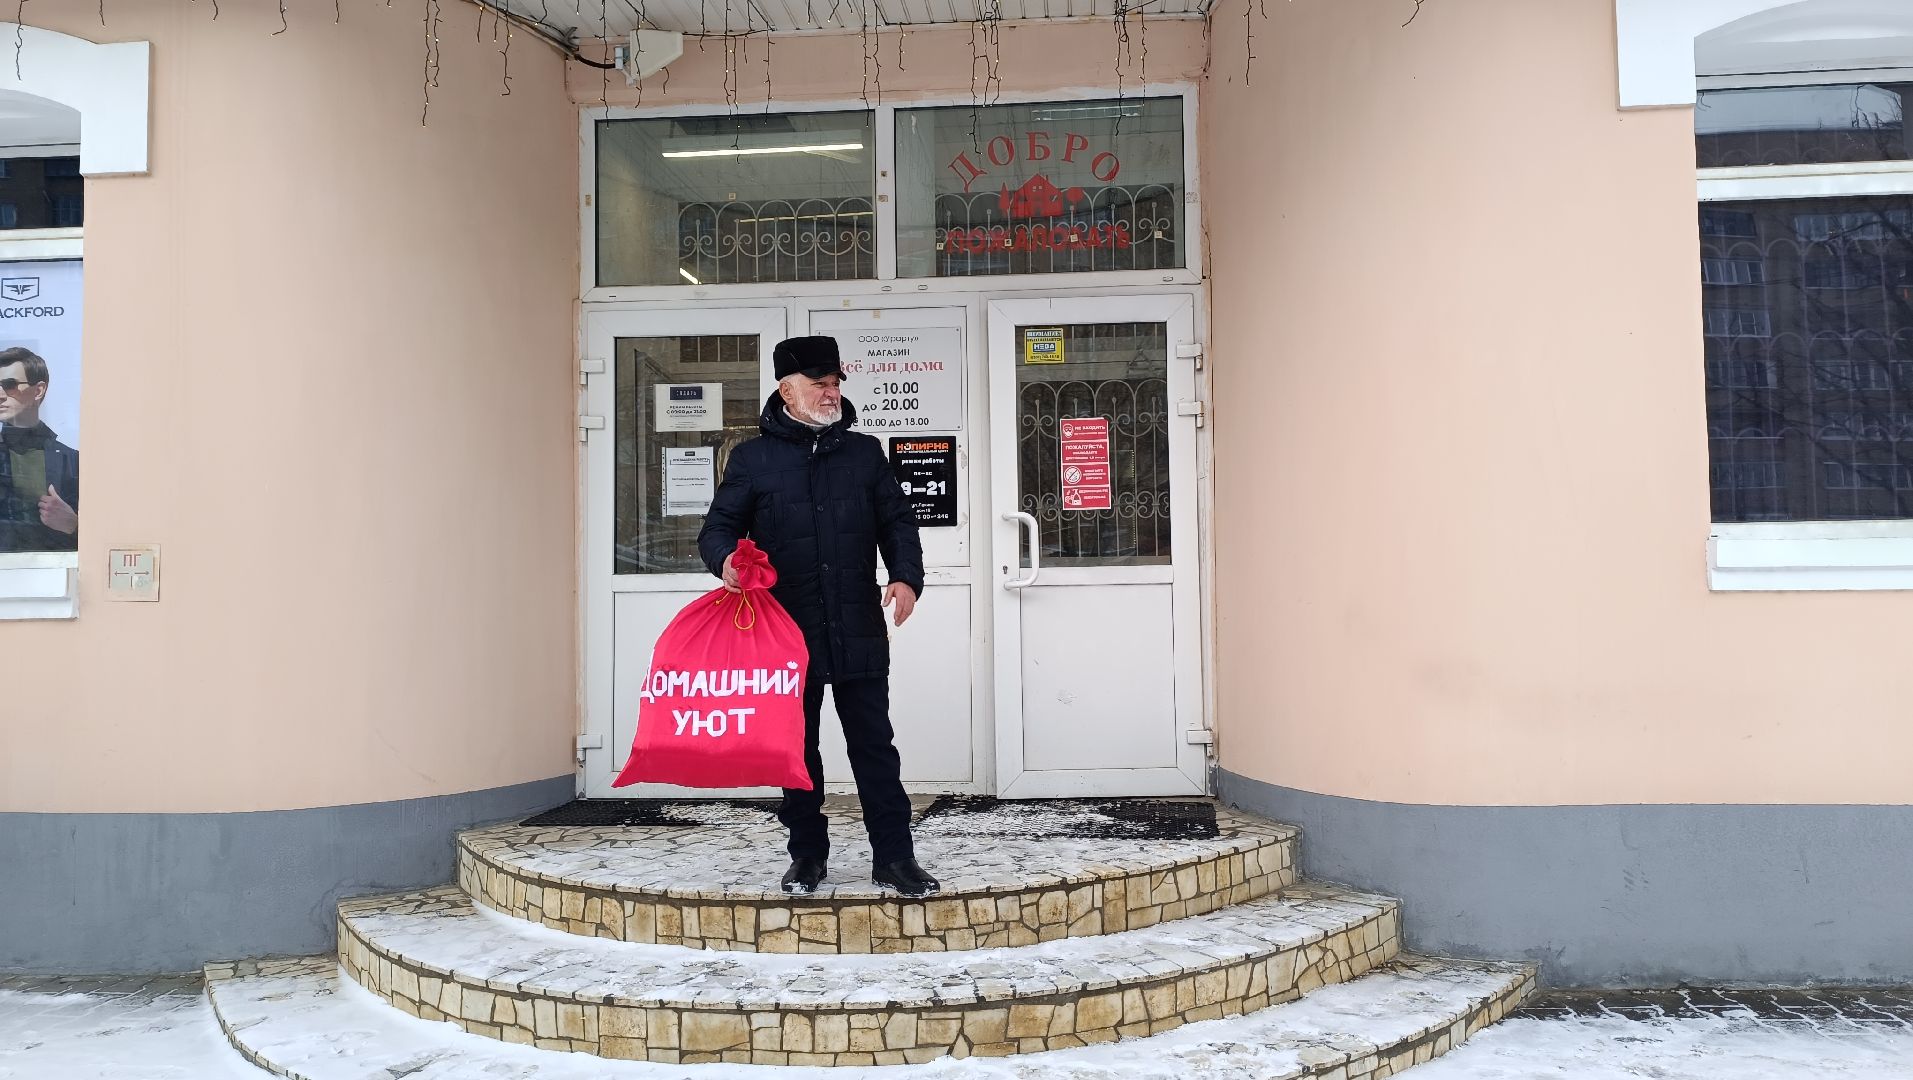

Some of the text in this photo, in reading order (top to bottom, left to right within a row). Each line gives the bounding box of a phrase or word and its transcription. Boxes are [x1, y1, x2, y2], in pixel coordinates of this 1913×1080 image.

[948, 131, 1120, 193] ДОБРО
[946, 225, 1131, 254] ПОЖАЛОВАТЬ
[858, 335, 880, 343] ООО
[867, 348, 910, 357] МАГАЗИН
[866, 362, 897, 375] для
[900, 361, 944, 375] дома
[873, 382, 919, 395] с 10.00
[862, 398, 919, 412] до 20.00
[862, 418, 887, 427] 10.00
[888, 420, 902, 428] до
[904, 417, 929, 426] 18.00
[922, 457, 945, 465] работы
[123, 553, 142, 567] ПГ
[640, 661, 800, 704] ДОМАШНИЙ
[672, 707, 756, 737] УЮТ
